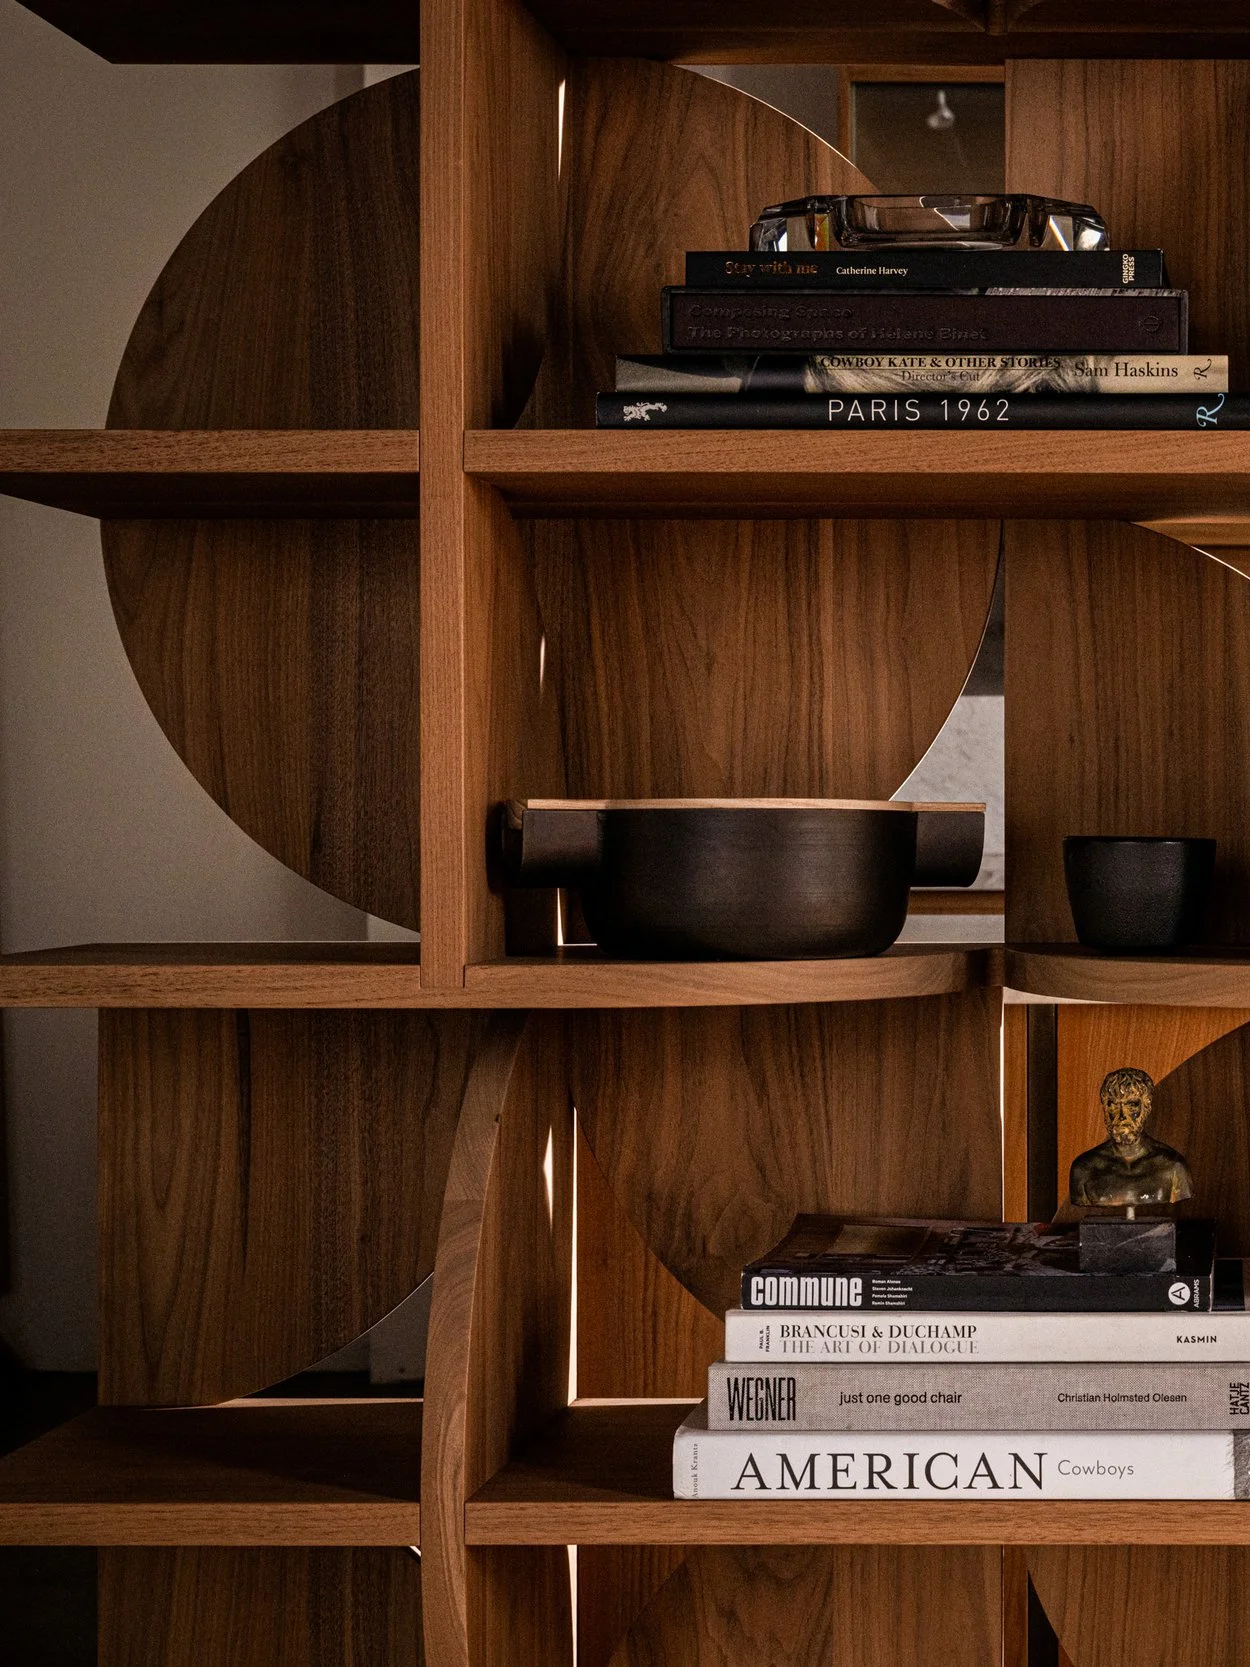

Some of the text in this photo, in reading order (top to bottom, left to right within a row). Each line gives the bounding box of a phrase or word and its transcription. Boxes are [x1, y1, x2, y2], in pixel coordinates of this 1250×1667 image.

[725, 260, 818, 277] Stay with me
[836, 266, 908, 277] Catherine Harvey
[688, 304, 791, 320] Composing
[688, 326, 721, 339] The
[727, 326, 843, 341] Photographs
[848, 326, 868, 339] of
[821, 356, 1061, 368] COWBOY KATE & OTHER STORIES
[1074, 361, 1179, 377] Sam Haskins
[959, 370, 980, 382] Cut
[828, 399, 1009, 421] PARIS 1962
[751, 1276, 863, 1307] commune
[779, 1325, 977, 1338] BRANCUSI & DUCHAMP
[779, 1340, 980, 1354] THE ART OF DIALOGUE
[1176, 1335, 1217, 1344] KASMIN
[726, 1376, 796, 1421] WEGNER
[839, 1391, 962, 1406] just one good chair
[1057, 1393, 1187, 1403] Christian Holmsted Olesen
[1229, 1382, 1240, 1415] HATJE
[1239, 1382, 1250, 1415] CANTZ
[730, 1451, 1134, 1491] AMERICAN Cowboys
